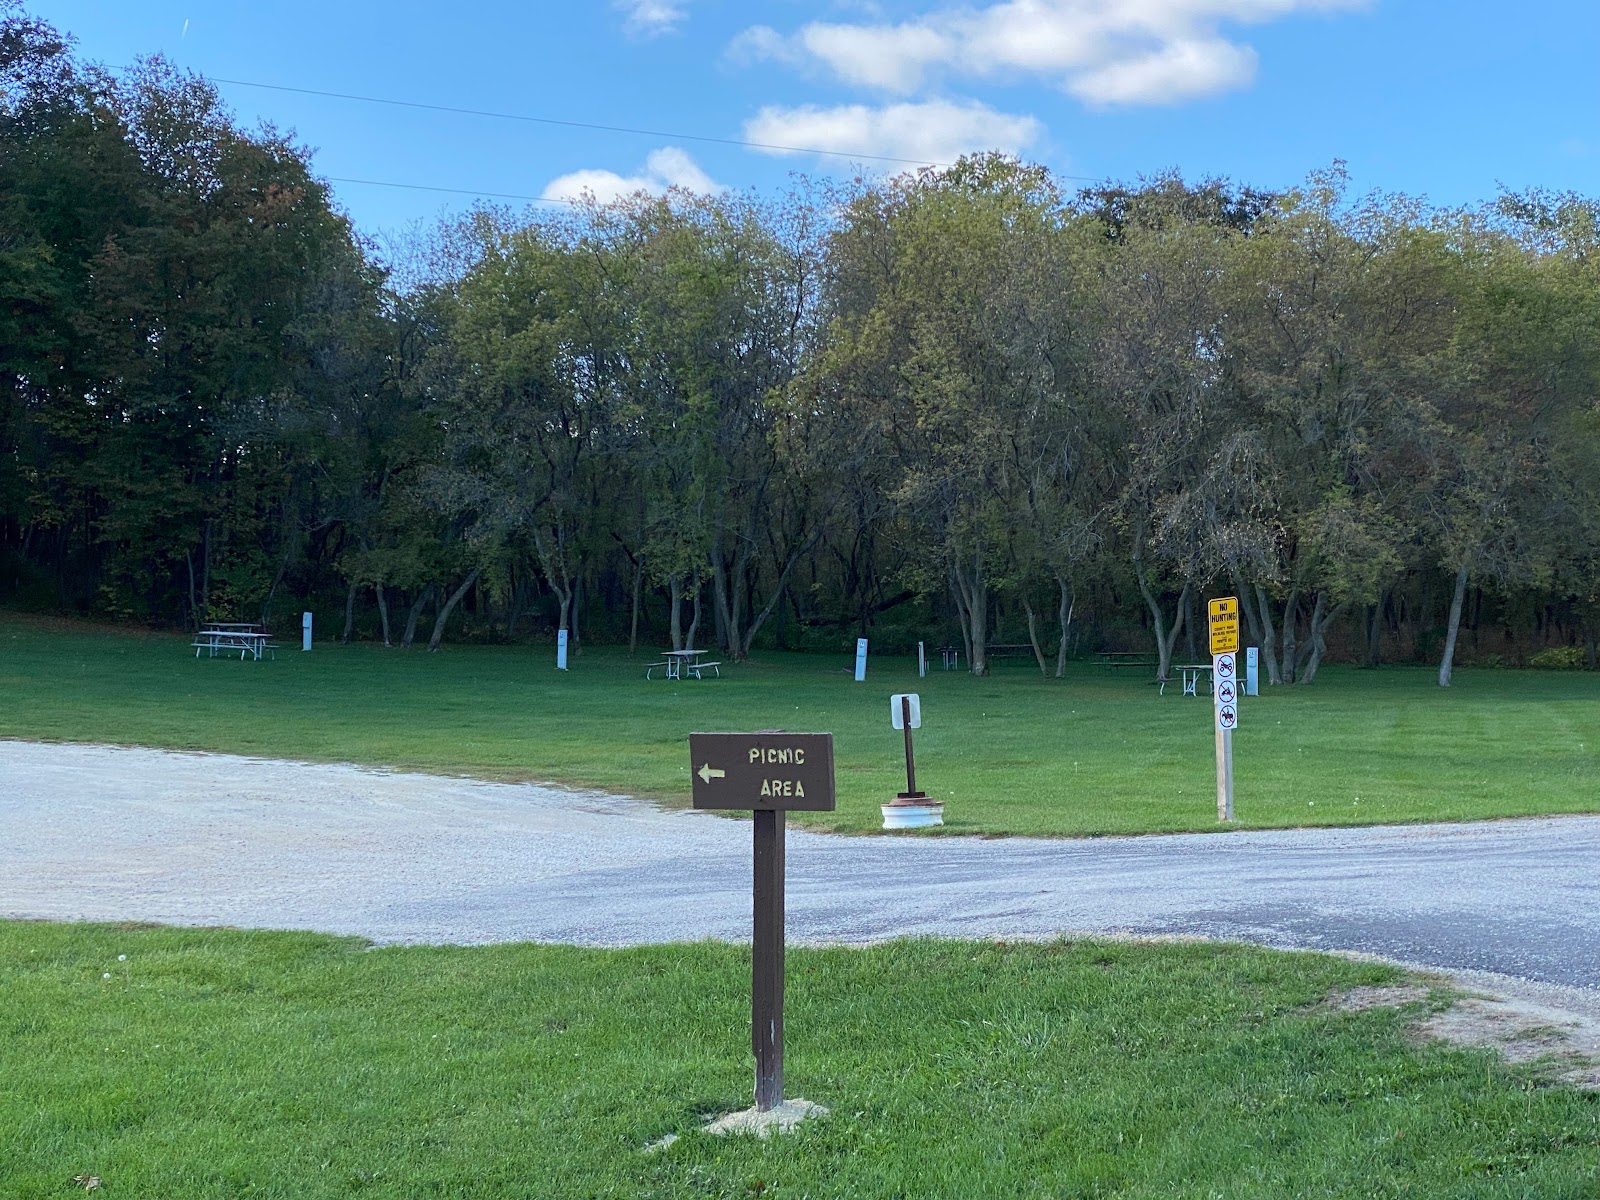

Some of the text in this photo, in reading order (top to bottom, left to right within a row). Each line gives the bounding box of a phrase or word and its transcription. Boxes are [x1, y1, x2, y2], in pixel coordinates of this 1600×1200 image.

[1219, 603, 1228, 611] NO
[1211, 612, 1236, 623] HUNTING
[749, 748, 805, 765] PICNIC
[760, 779, 805, 798] AREA
